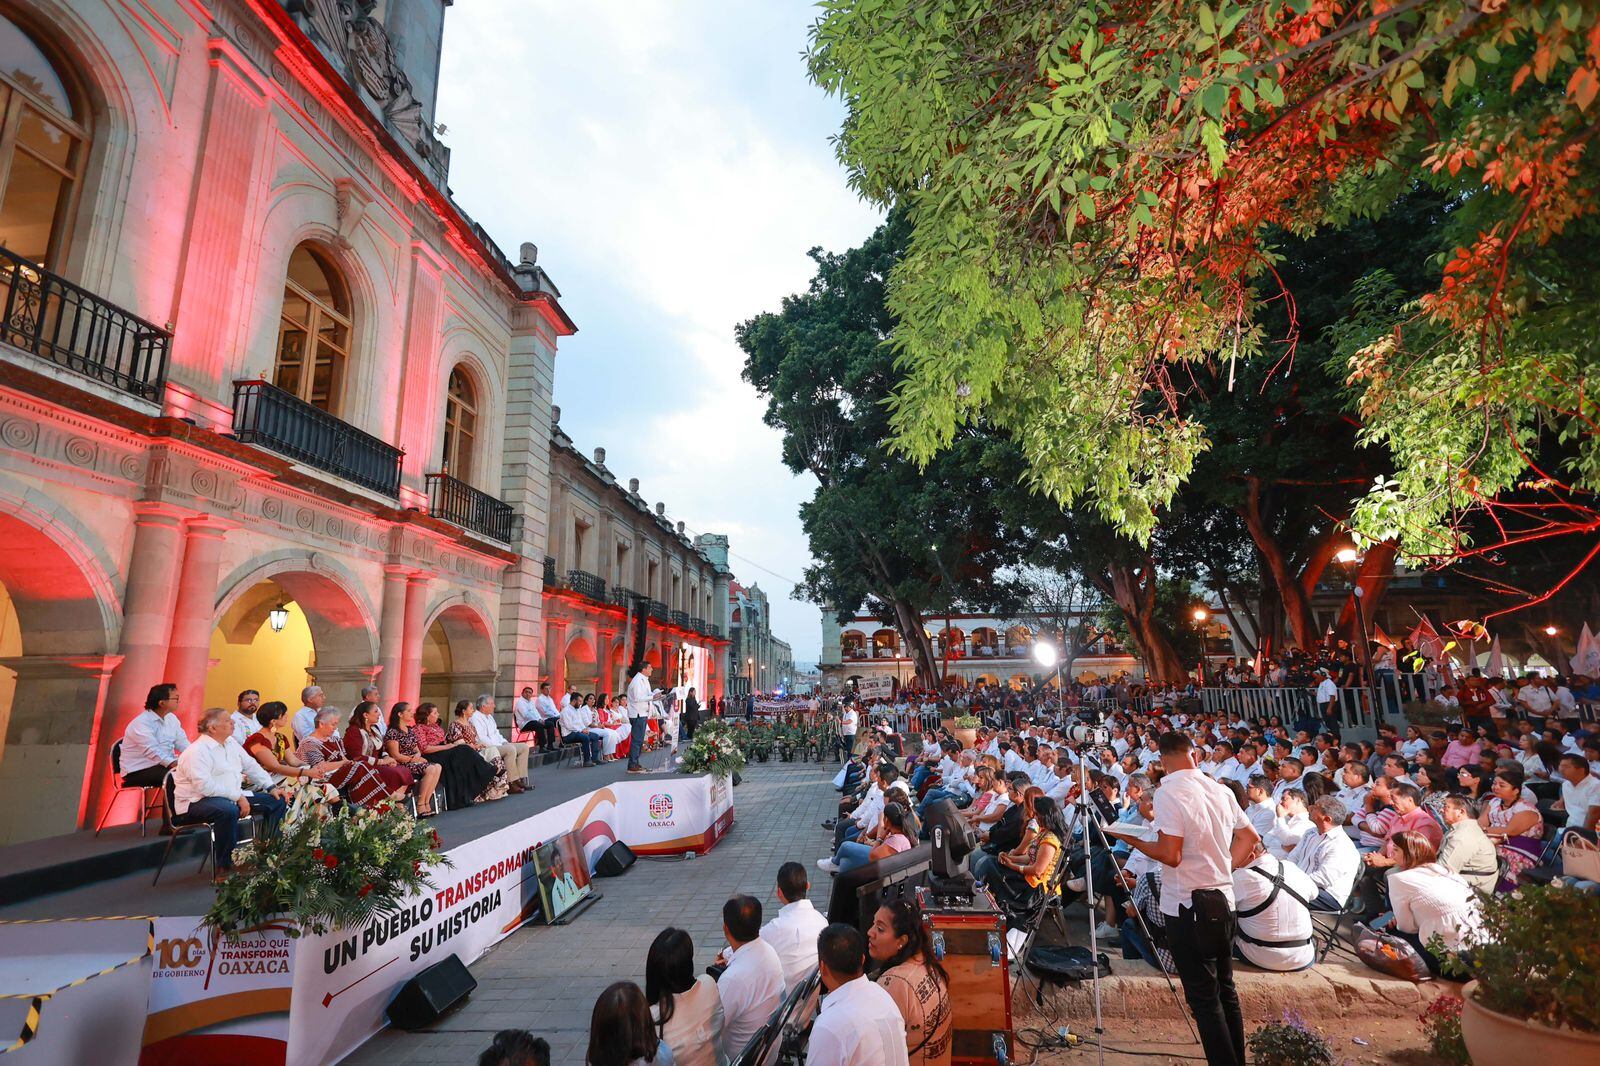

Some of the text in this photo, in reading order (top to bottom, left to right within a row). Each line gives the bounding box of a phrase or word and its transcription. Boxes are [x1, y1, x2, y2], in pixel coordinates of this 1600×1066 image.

[647, 820, 675, 828] OAXACA
[409, 889, 502, 962] SU HISTORIA
[323, 934, 357, 974] UN
[362, 898, 433, 955] PUEBLO
[222, 939, 290, 949] TRABAJO QUE
[156, 938, 203, 969] 100
[220, 950, 290, 960] TRANSFORMA
[218, 960, 290, 975] OAXACA
[164, 970, 205, 978] GOBIERNO
